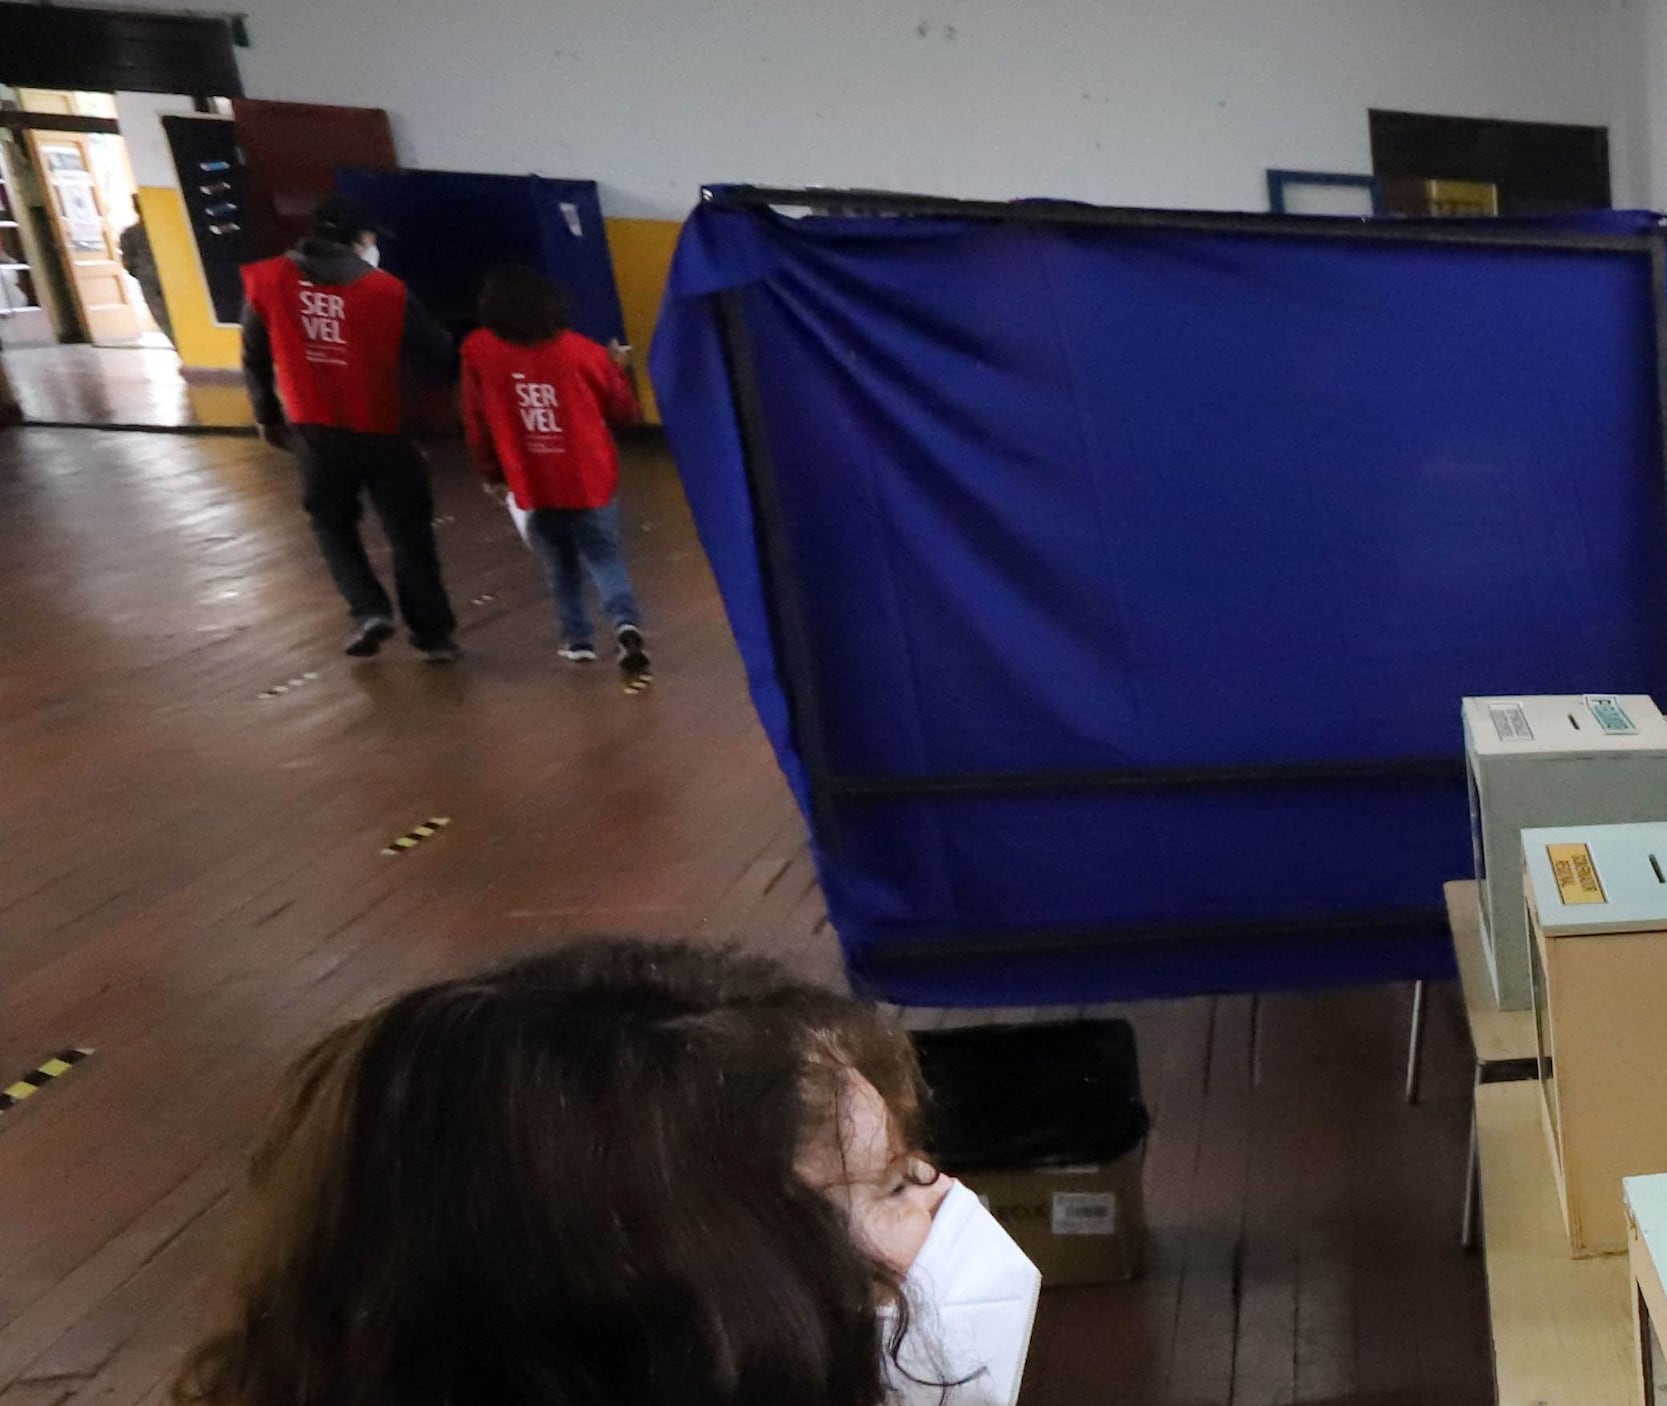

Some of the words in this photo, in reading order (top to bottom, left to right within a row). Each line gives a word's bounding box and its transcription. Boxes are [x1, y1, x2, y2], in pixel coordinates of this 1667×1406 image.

[299, 291, 346, 320] SER
[301, 315, 348, 344] VEL
[515, 383, 559, 408] SER
[519, 407, 564, 432] VEL
